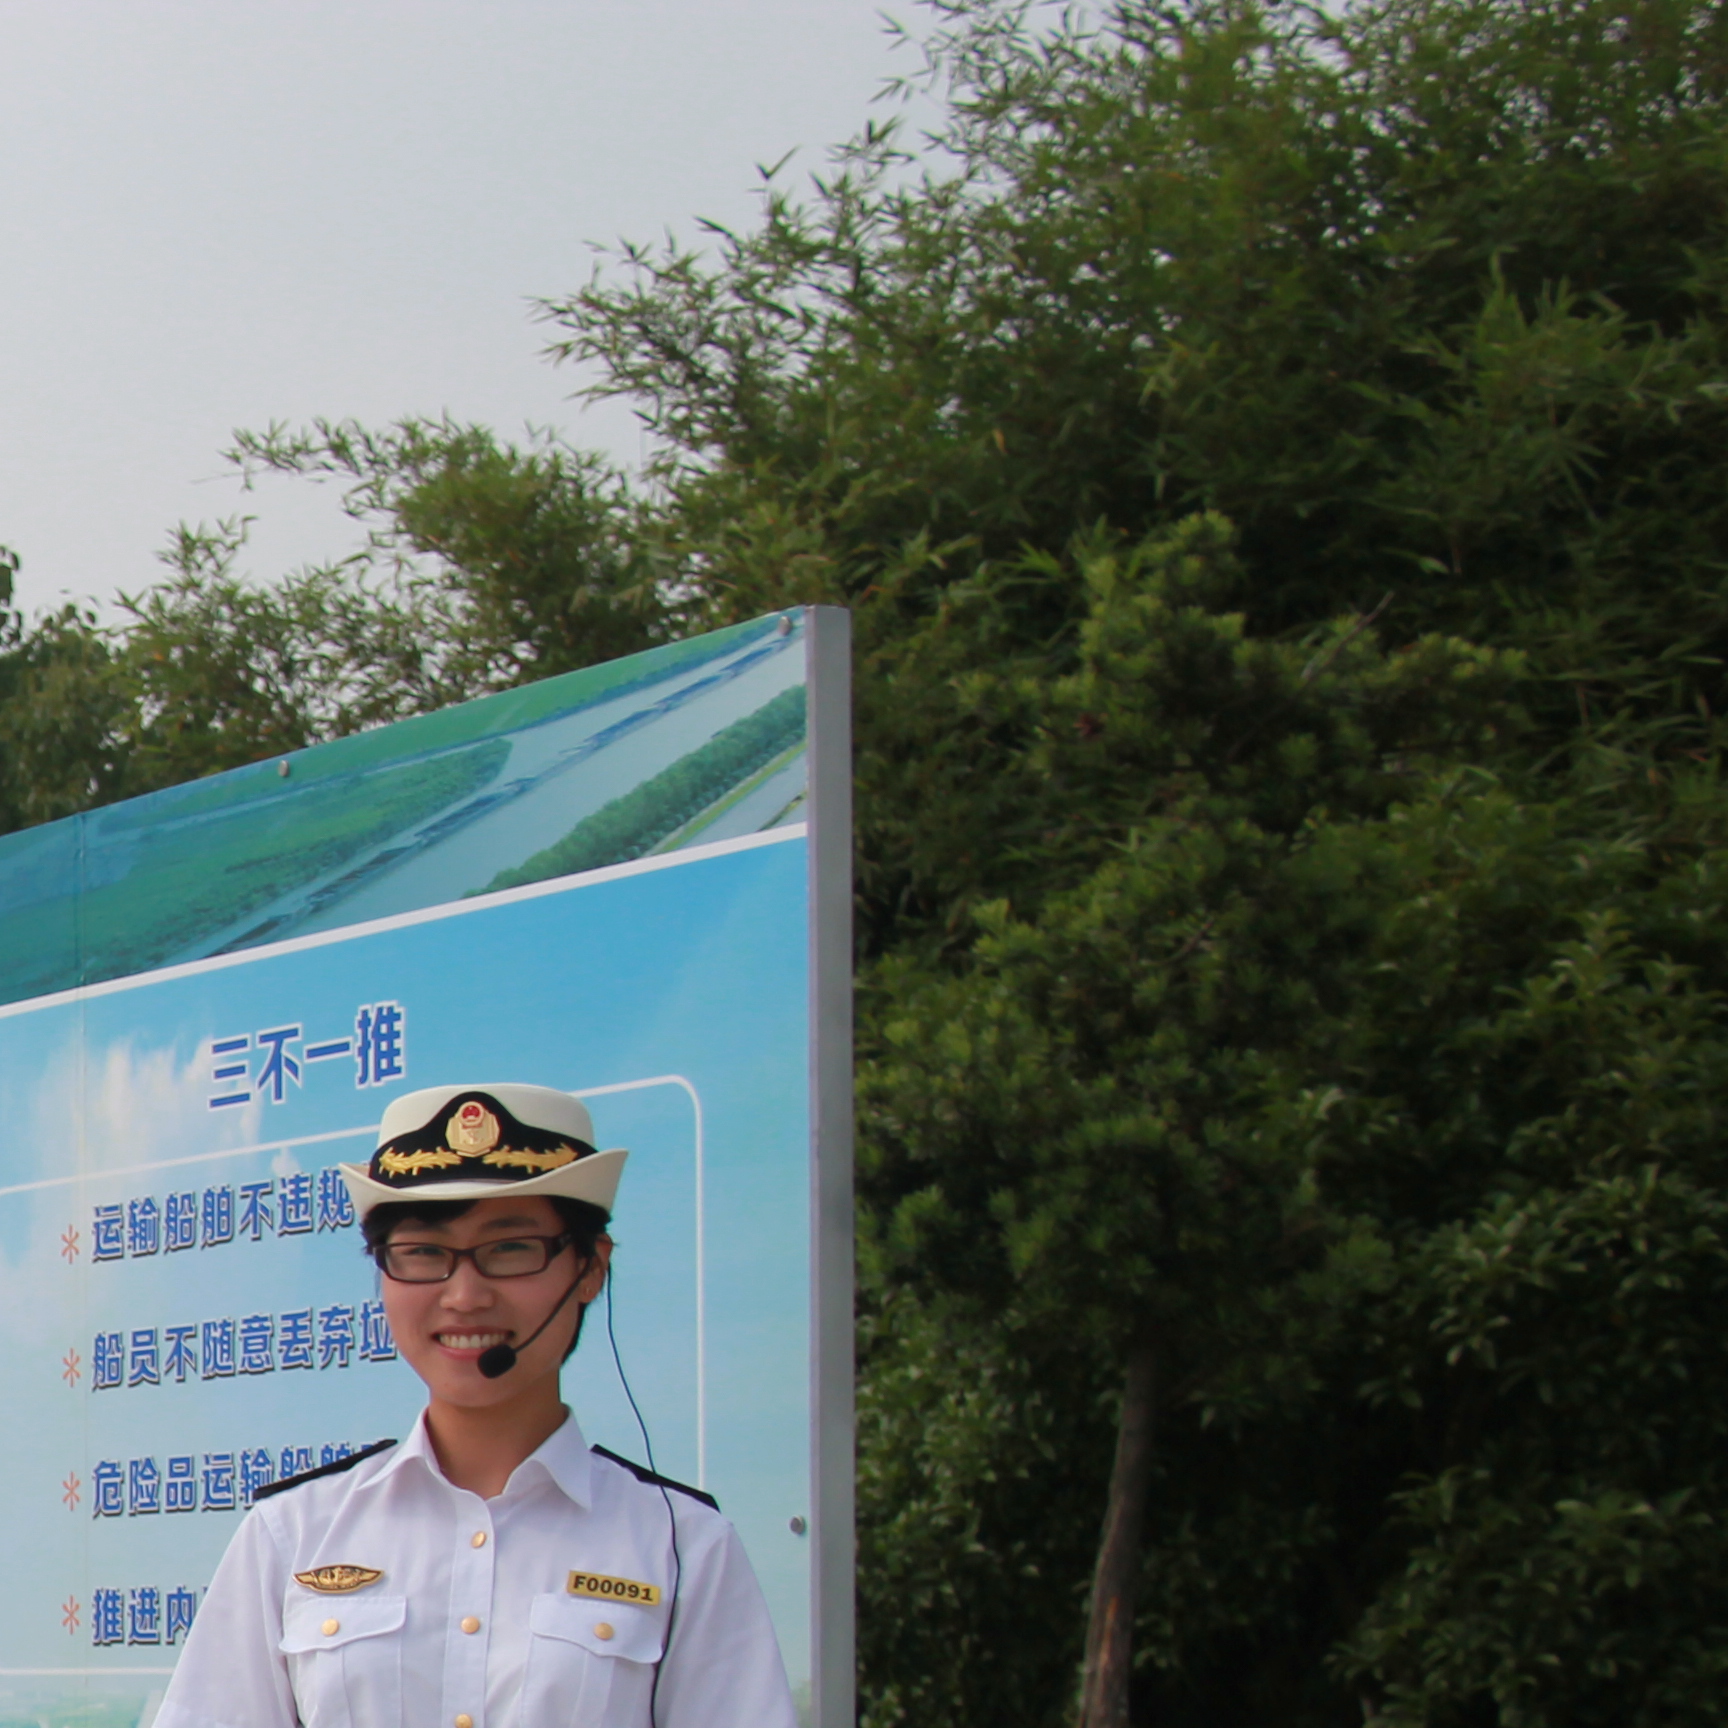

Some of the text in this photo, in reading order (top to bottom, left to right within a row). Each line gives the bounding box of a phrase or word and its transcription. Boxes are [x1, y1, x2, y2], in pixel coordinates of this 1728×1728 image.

[210, 1002, 406, 1109] 三不一推
[92, 1168, 353, 1262] 运输船舶不违规
[93, 1300, 396, 1390] 船员不随意丢弃垃
[573, 1575, 653, 1601] F00091
